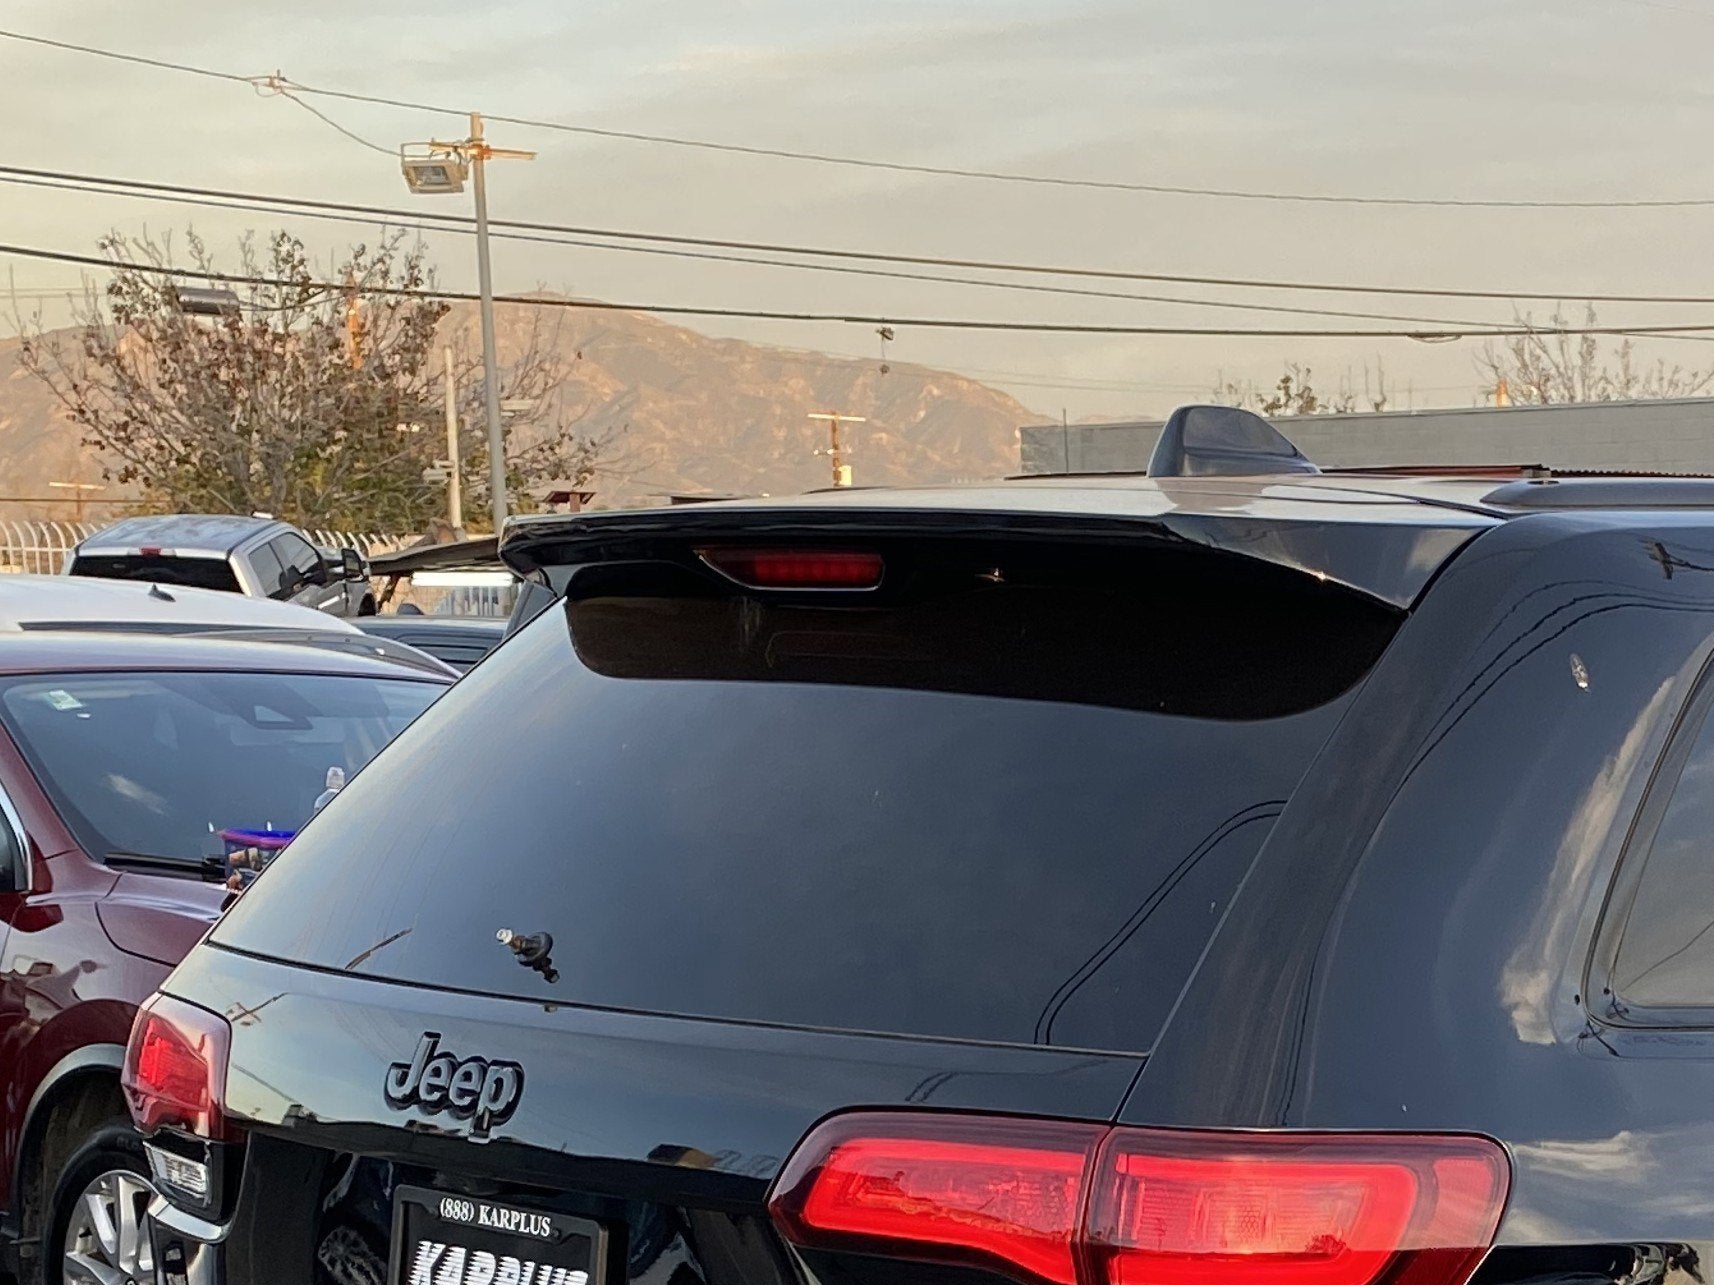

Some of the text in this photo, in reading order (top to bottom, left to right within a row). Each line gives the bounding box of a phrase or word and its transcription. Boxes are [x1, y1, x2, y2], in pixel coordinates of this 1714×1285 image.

[384, 1031, 525, 1141] Jeep
[439, 1197, 552, 1237] (888) KARPLUS
